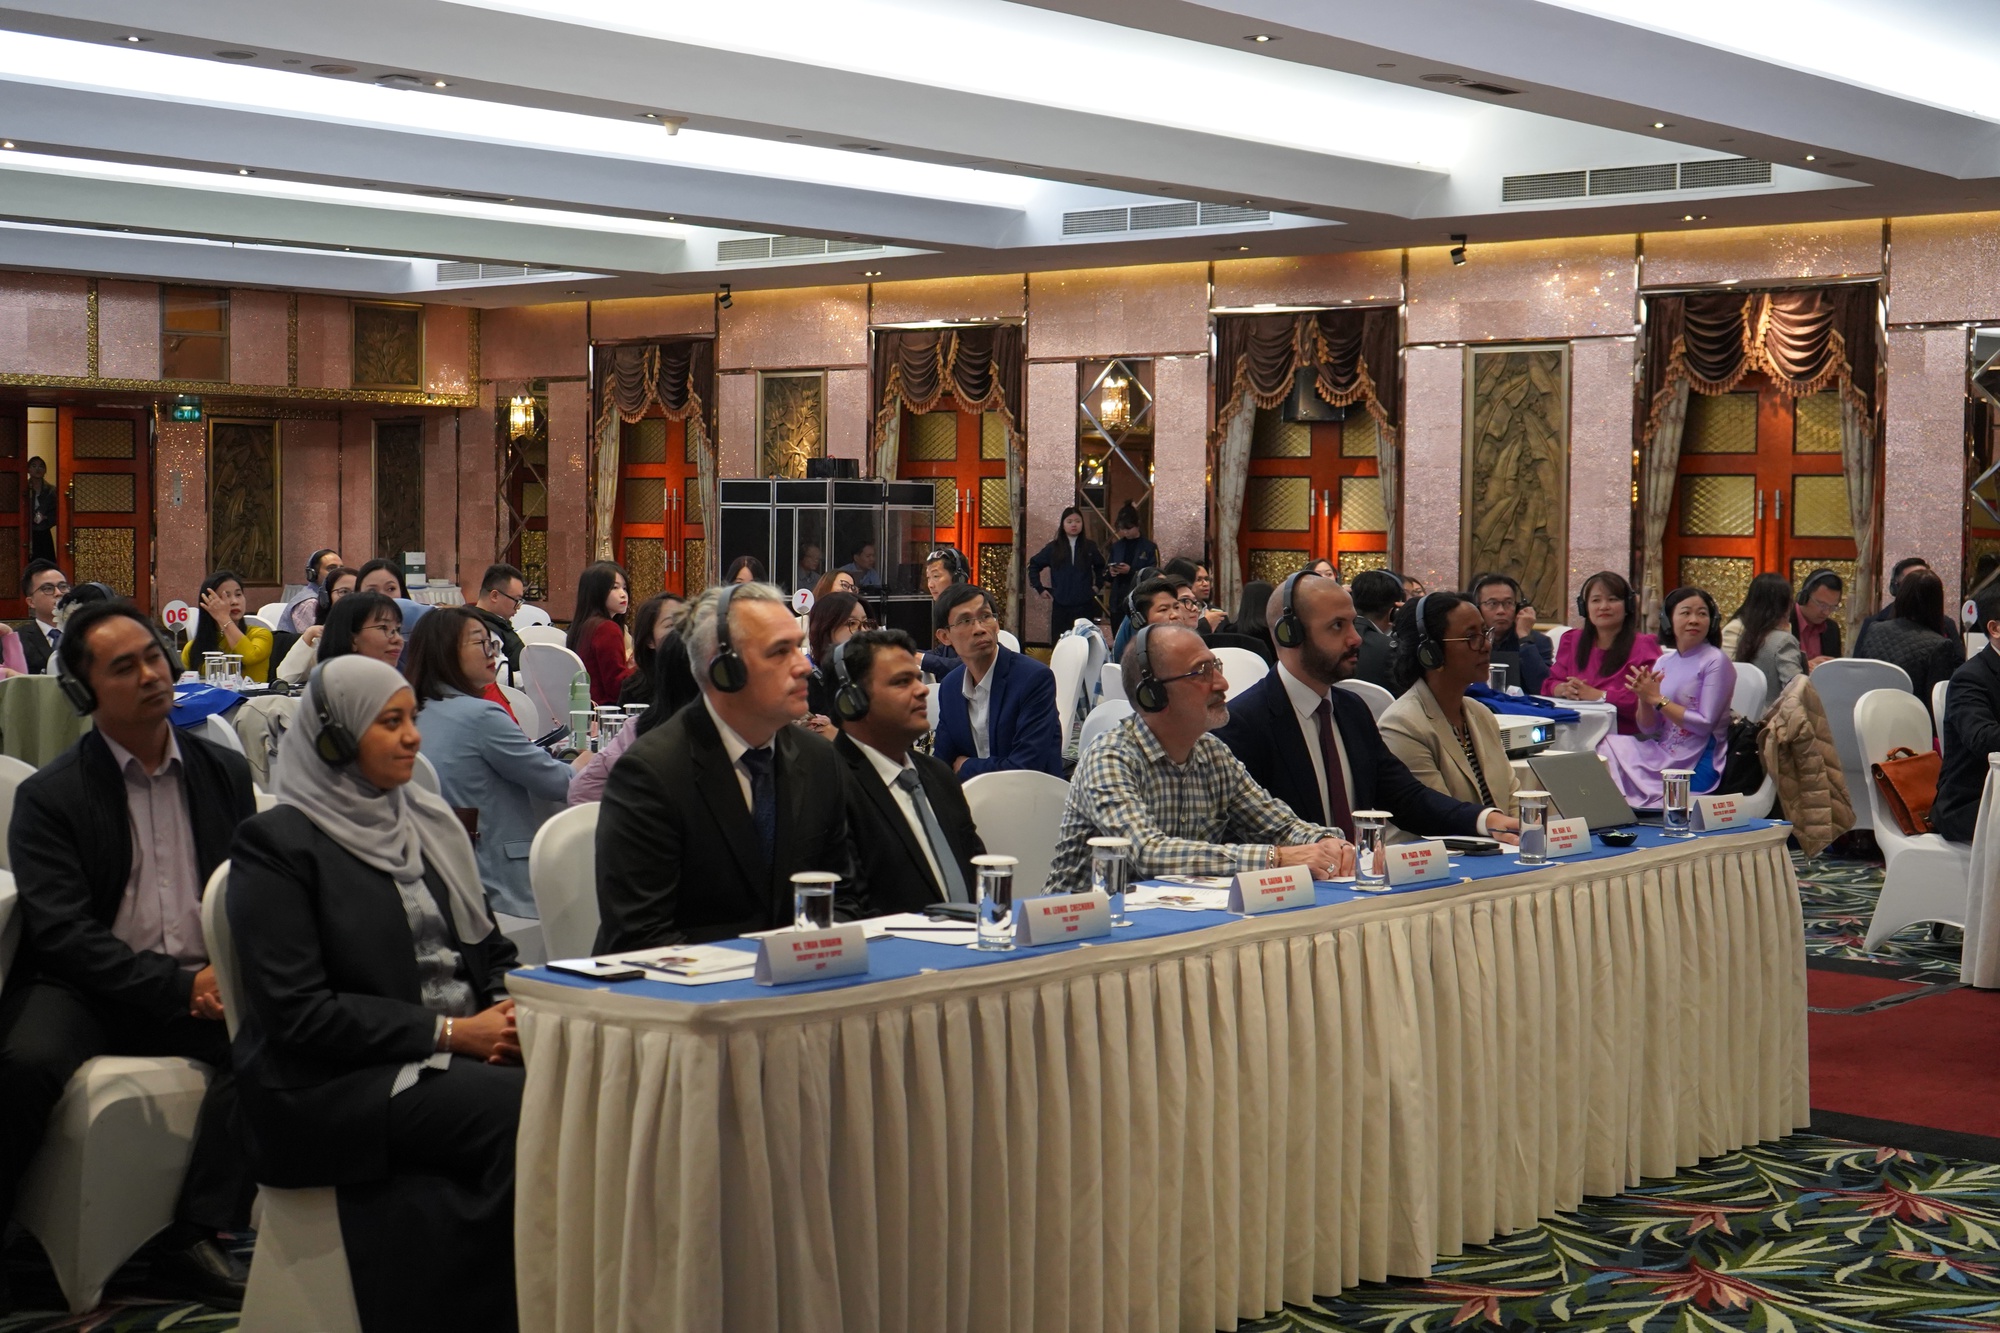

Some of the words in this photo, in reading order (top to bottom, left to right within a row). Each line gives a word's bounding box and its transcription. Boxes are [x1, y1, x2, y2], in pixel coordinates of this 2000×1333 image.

[801, 593, 808, 604] 7
[1967, 604, 1973, 615] 4
[166, 607, 188, 624] 06
